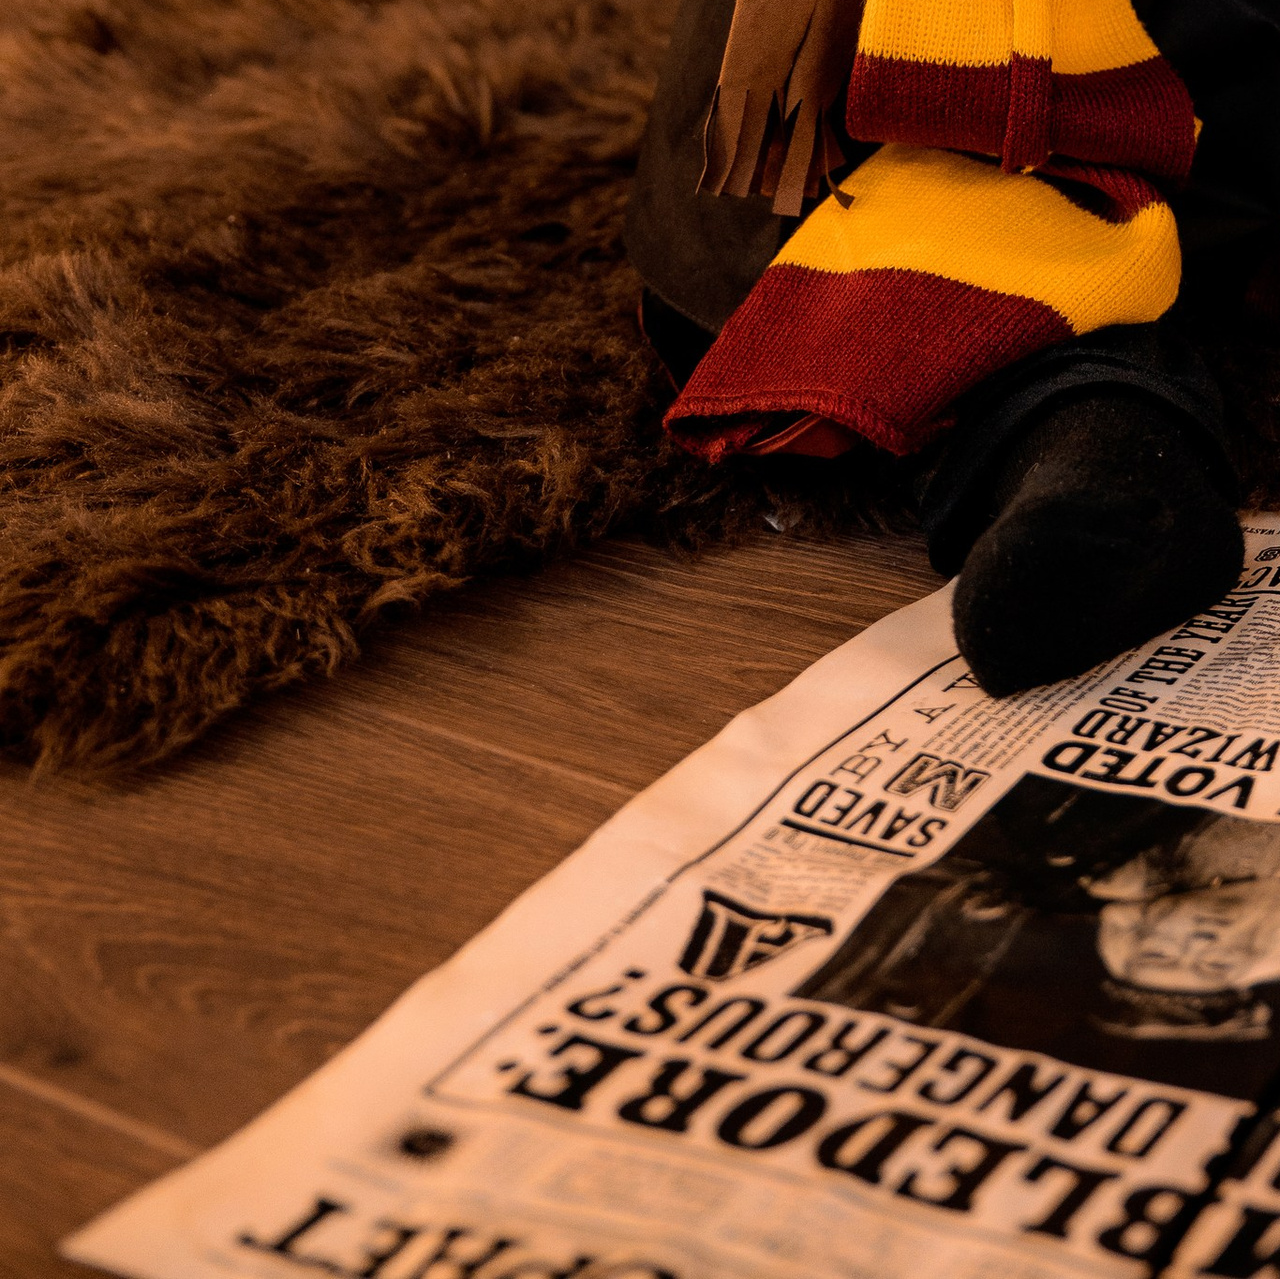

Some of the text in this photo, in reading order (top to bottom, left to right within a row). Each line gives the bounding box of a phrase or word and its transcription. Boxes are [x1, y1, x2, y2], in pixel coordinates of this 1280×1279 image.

[1098, 595, 1260, 713] OF THE YEAR
[828, 728, 910, 786] BY
[1041, 741, 1256, 809] VOTED
[792, 780, 949, 848] SAVED
[565, 968, 1189, 1160] DANGEROUS?
